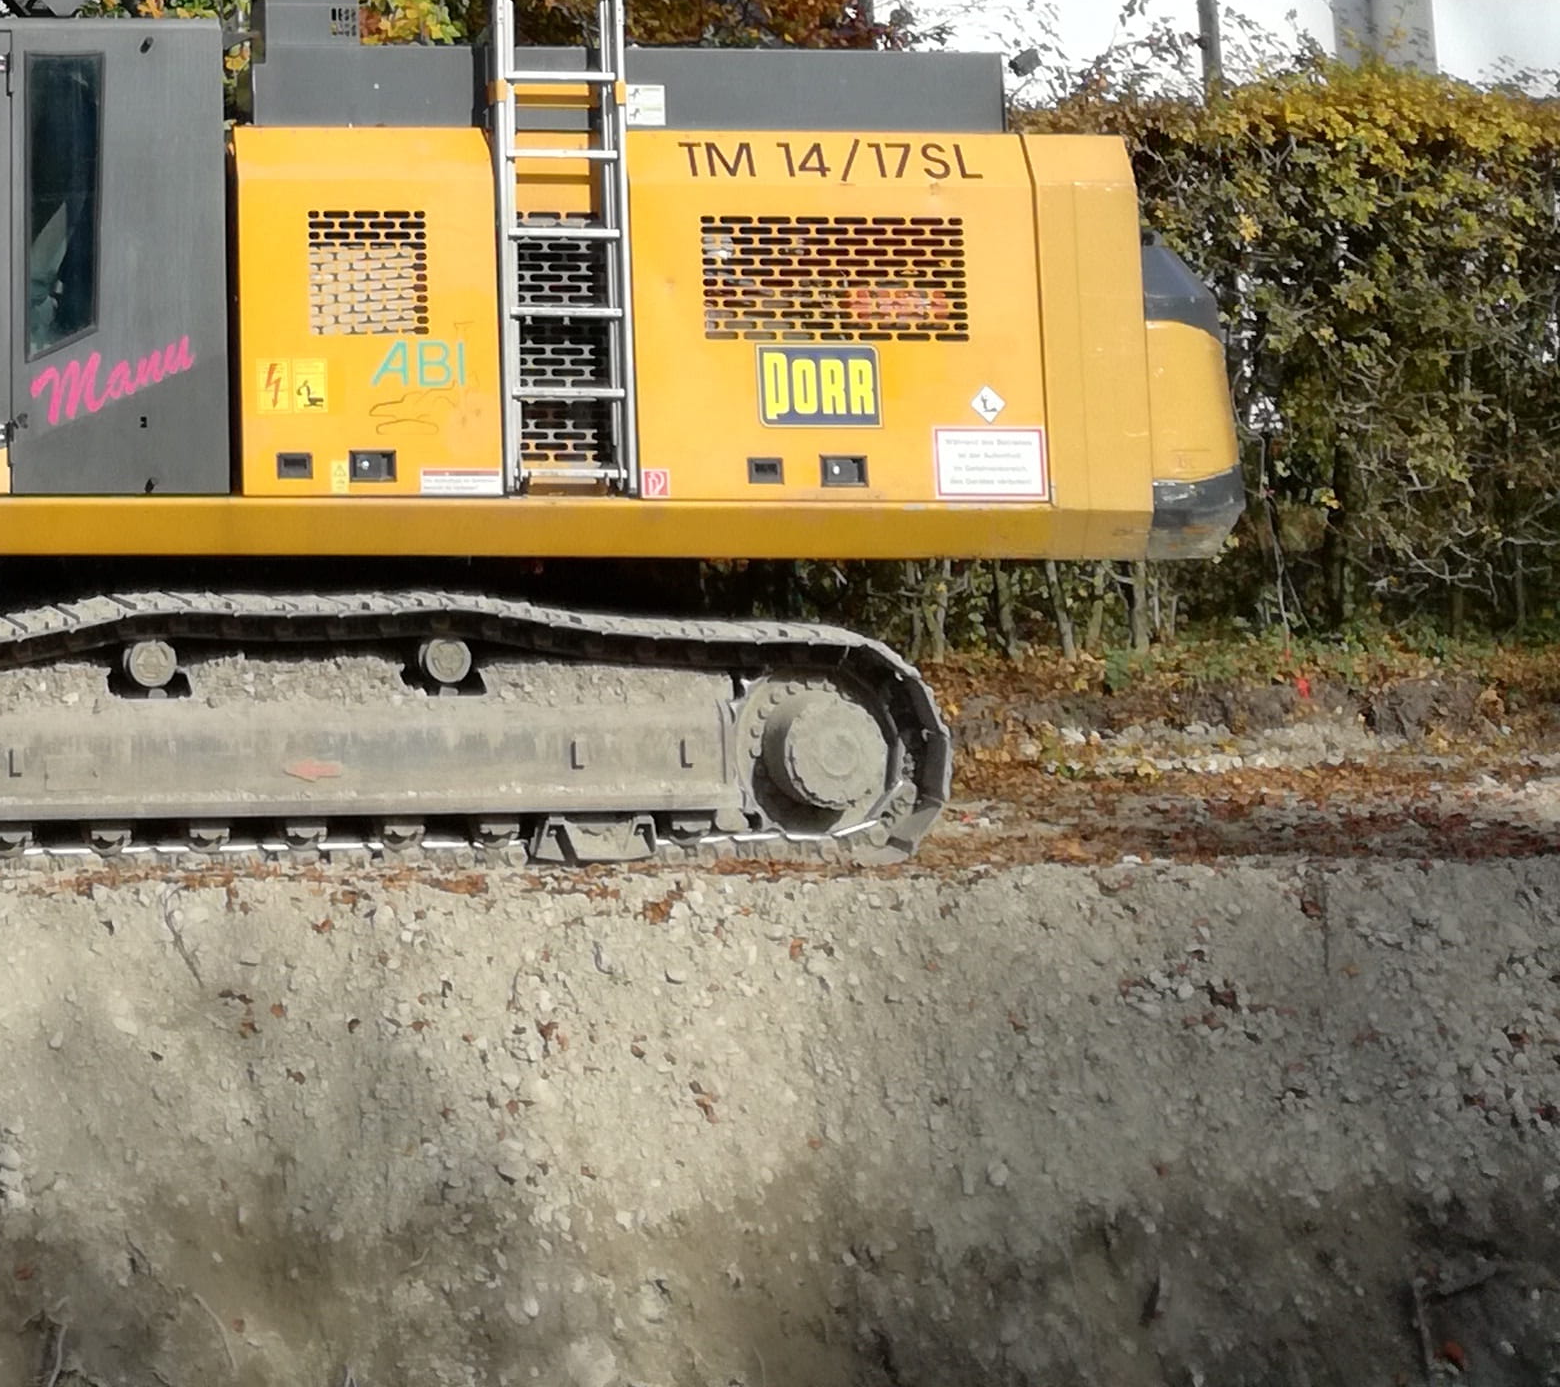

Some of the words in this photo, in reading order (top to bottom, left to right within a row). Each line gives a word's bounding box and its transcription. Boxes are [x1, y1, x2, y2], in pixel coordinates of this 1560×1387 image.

[677, 141, 756, 177] TM
[30, 334, 196, 425] Manu
[371, 340, 465, 387] ABI
[762, 352, 876, 420] PORR
